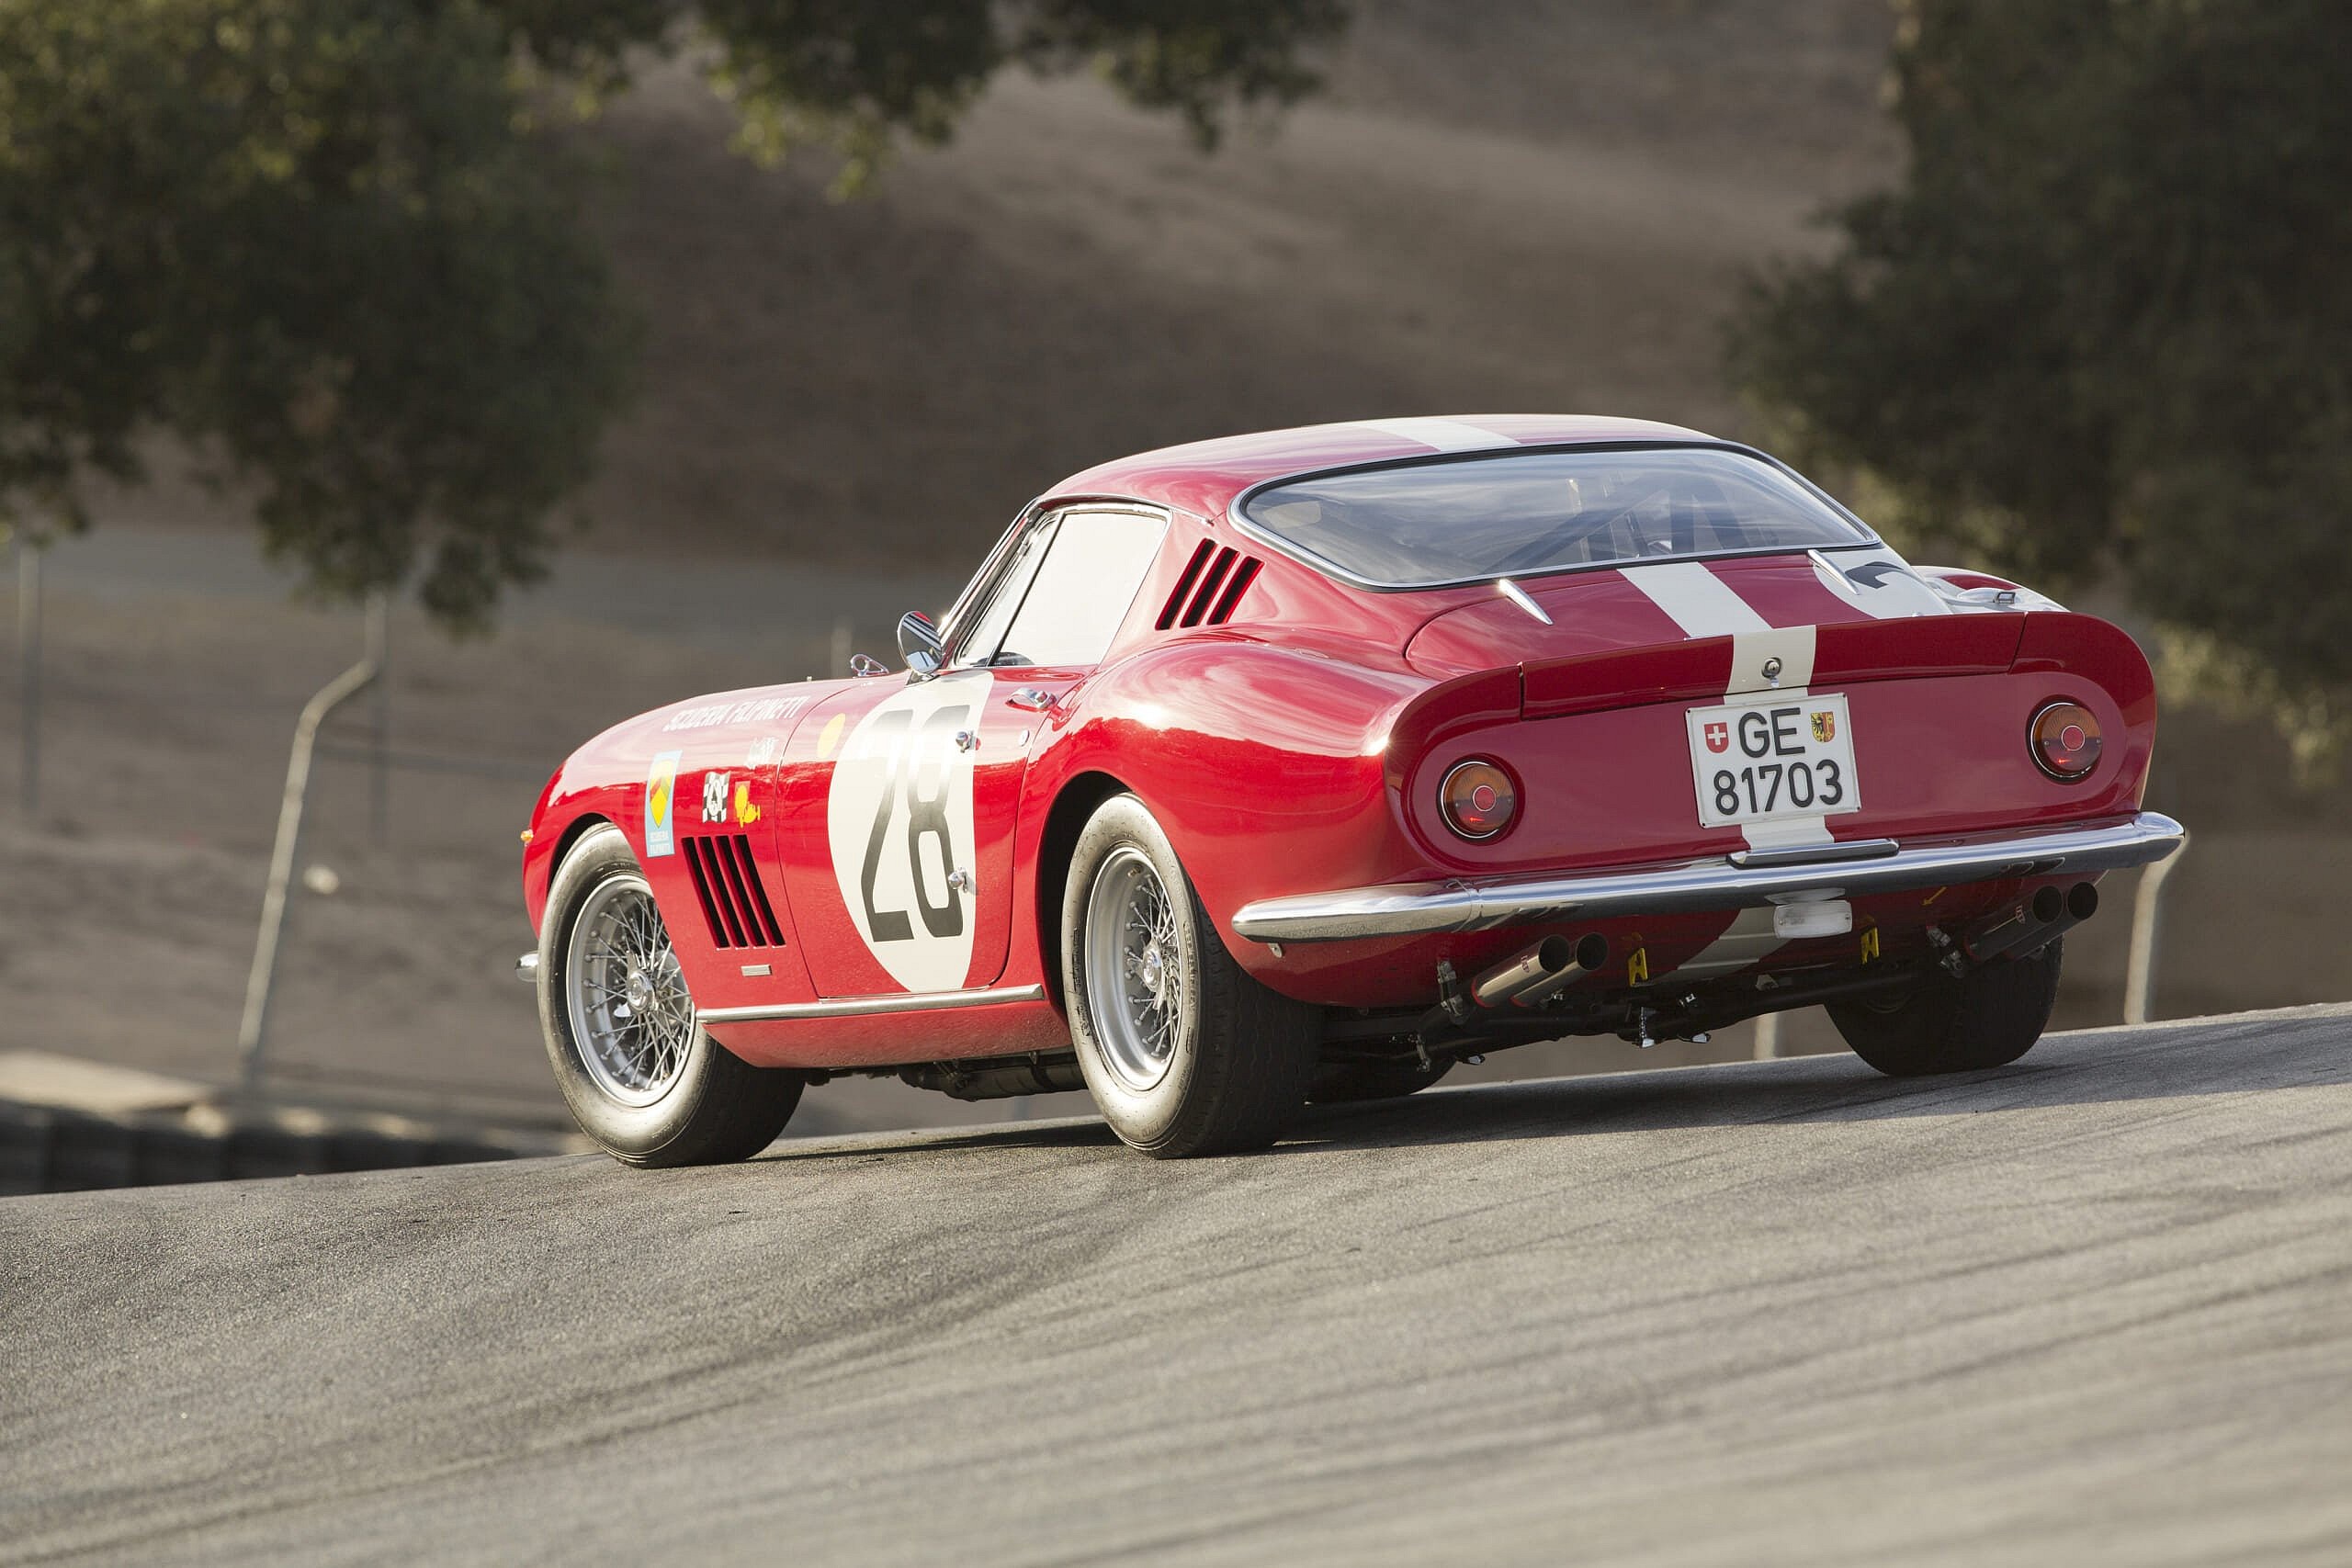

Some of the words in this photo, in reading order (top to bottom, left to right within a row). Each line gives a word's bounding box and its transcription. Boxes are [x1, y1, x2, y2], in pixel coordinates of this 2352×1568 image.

[1738, 707, 1805, 759] GE
[1713, 759, 1843, 816] 81703
[860, 704, 971, 942] 28
